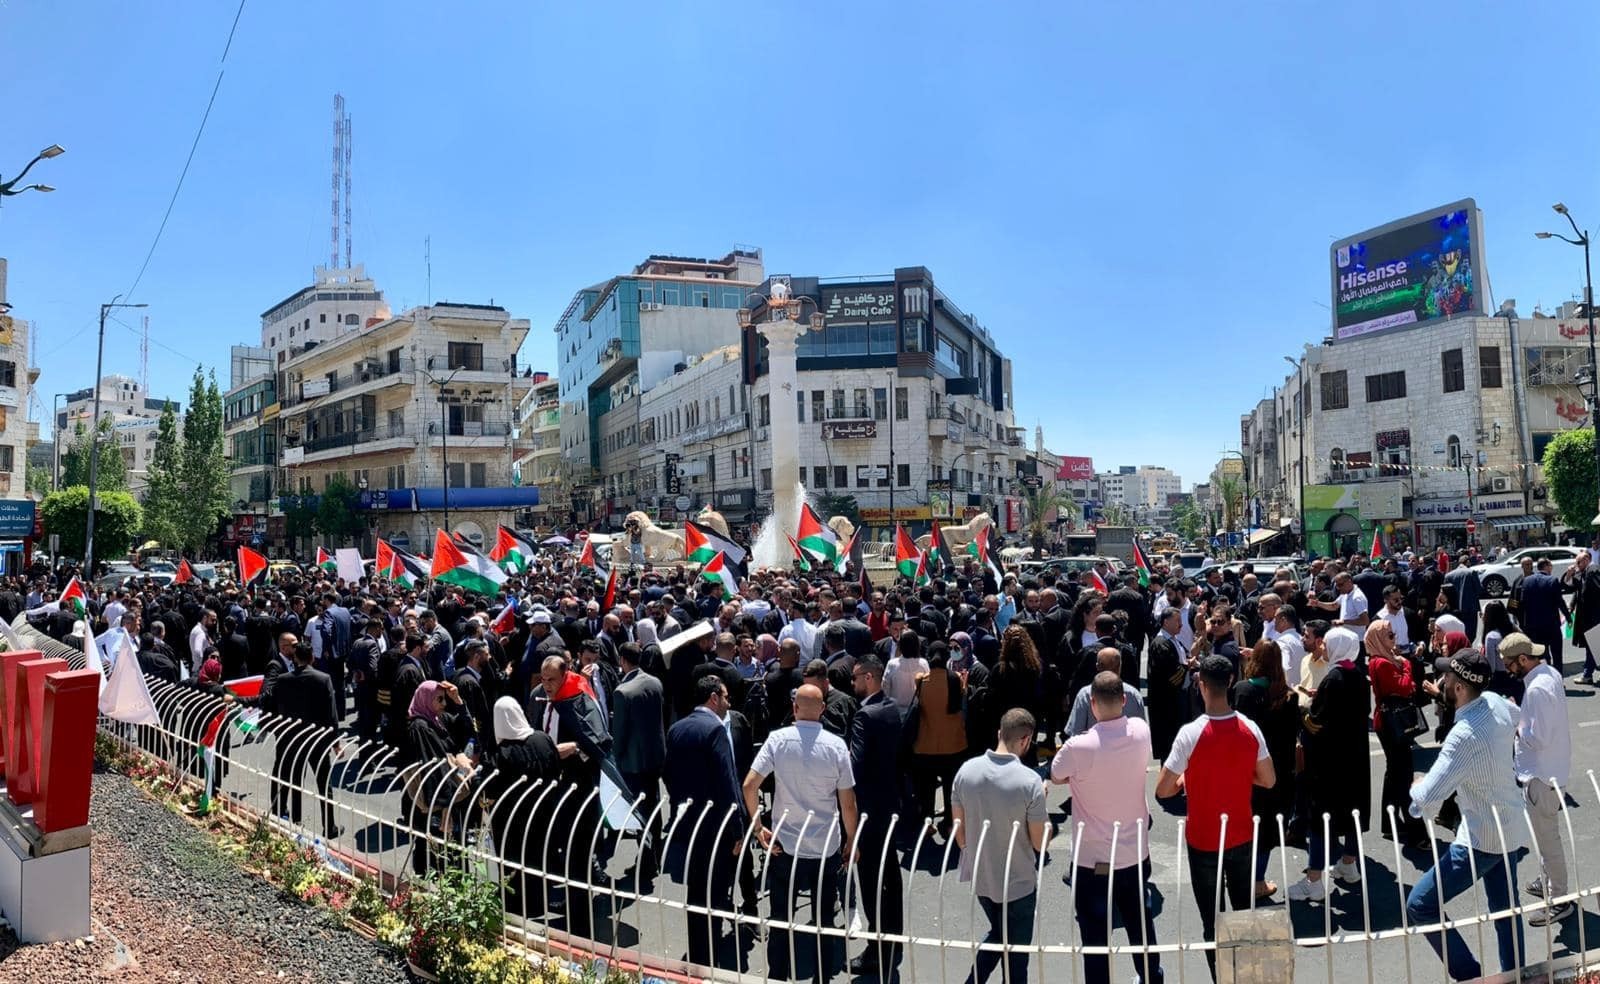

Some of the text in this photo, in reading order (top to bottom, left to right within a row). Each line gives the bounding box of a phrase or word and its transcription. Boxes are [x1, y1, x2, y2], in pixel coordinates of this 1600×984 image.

[1340, 261, 1407, 291] Hisense
[843, 293, 894, 306] درج كافيه
[843, 307, 869, 317] Daraj
[1450, 659, 1484, 683] adidas
